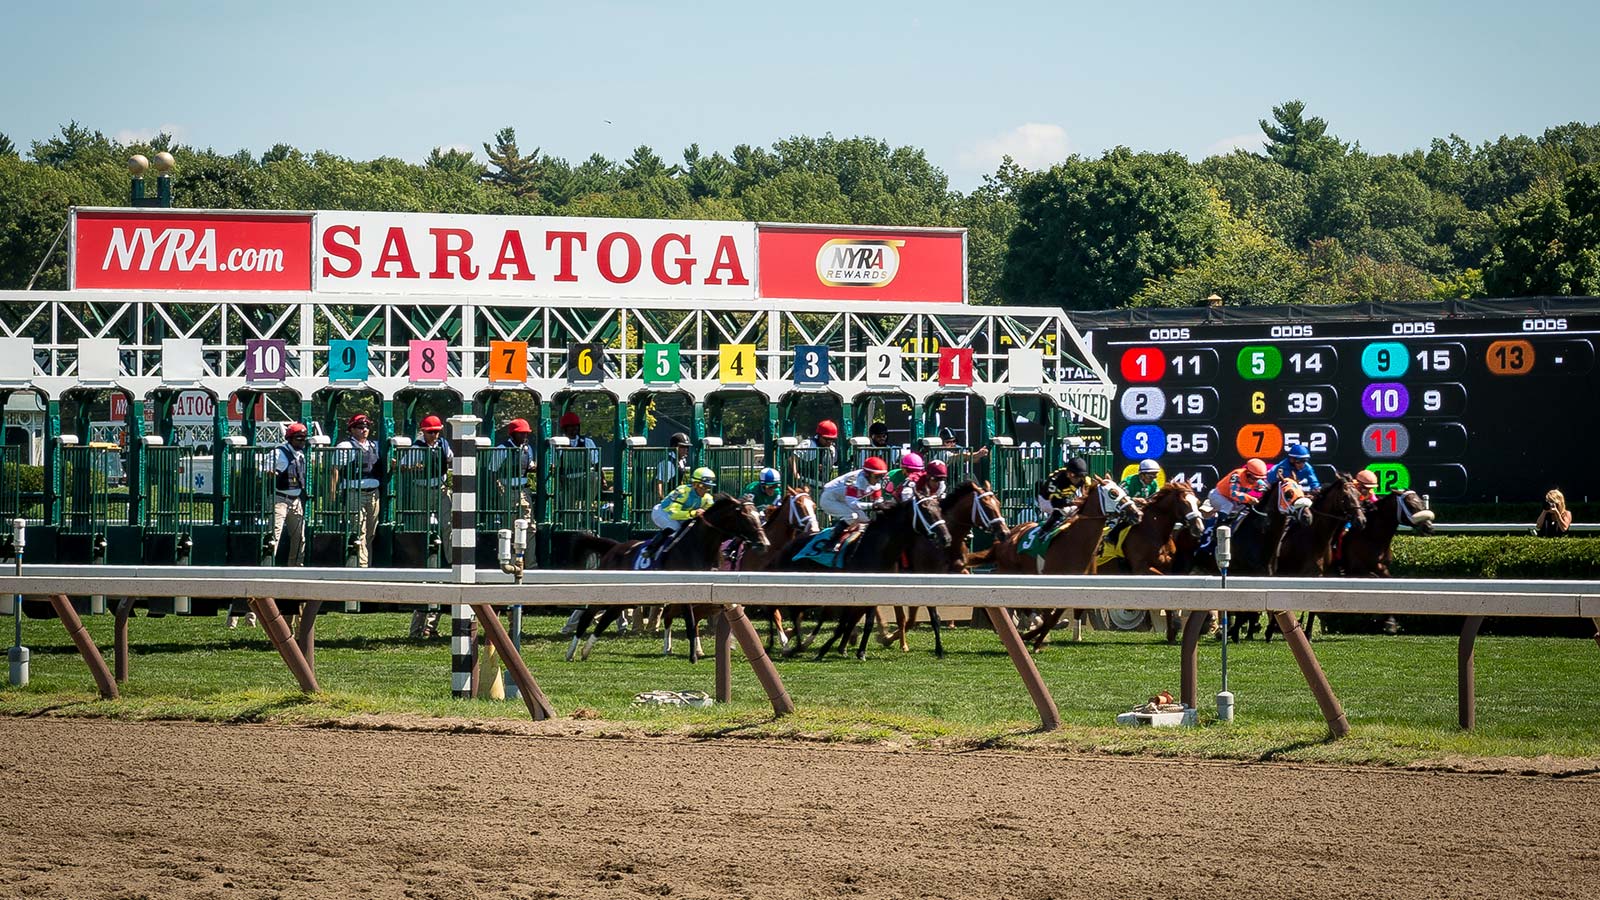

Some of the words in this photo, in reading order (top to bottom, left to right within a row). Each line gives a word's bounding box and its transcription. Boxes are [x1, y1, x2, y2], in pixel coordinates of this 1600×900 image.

[102, 227, 284, 272] NYRA.com
[322, 225, 749, 286] SARATOGA
[831, 247, 884, 269] NYRA
[826, 270, 887, 279] REWARDS
[1150, 328, 1190, 340] ODDS
[1271, 325, 1313, 337] ODDS
[1392, 322, 1435, 334] ODDS
[1522, 319, 1568, 331] ODDS
[252, 346, 281, 374] 10
[342, 347, 356, 373] 9
[422, 348, 435, 373] 8
[503, 349, 515, 374] 7
[578, 348, 593, 376] 6
[656, 350, 670, 376] 5
[730, 351, 744, 376] 4
[805, 352, 819, 378] 3
[879, 353, 891, 378] 2
[951, 354, 960, 380] 1
[1136, 354, 1147, 376] 1
[1172, 356, 1200, 375] 11
[1251, 352, 1265, 375] 5
[1289, 353, 1322, 373] 14
[1377, 349, 1391, 372] 9
[1416, 350, 1450, 371] 15
[1496, 346, 1523, 370] 13
[1060, 392, 1108, 421] UNITED
[1135, 393, 1148, 415] 2
[1172, 394, 1204, 414] 19
[1251, 391, 1265, 414] 6
[1287, 392, 1322, 413] 39
[1370, 389, 1399, 412] 10
[1423, 389, 1441, 411] 9
[1135, 432, 1148, 454] 3
[1166, 434, 1208, 453] 8-5
[1252, 431, 1265, 452] 7
[1284, 433, 1326, 452] 5-2
[1370, 429, 1397, 452] 11
[1375, 470, 1398, 492] 12
